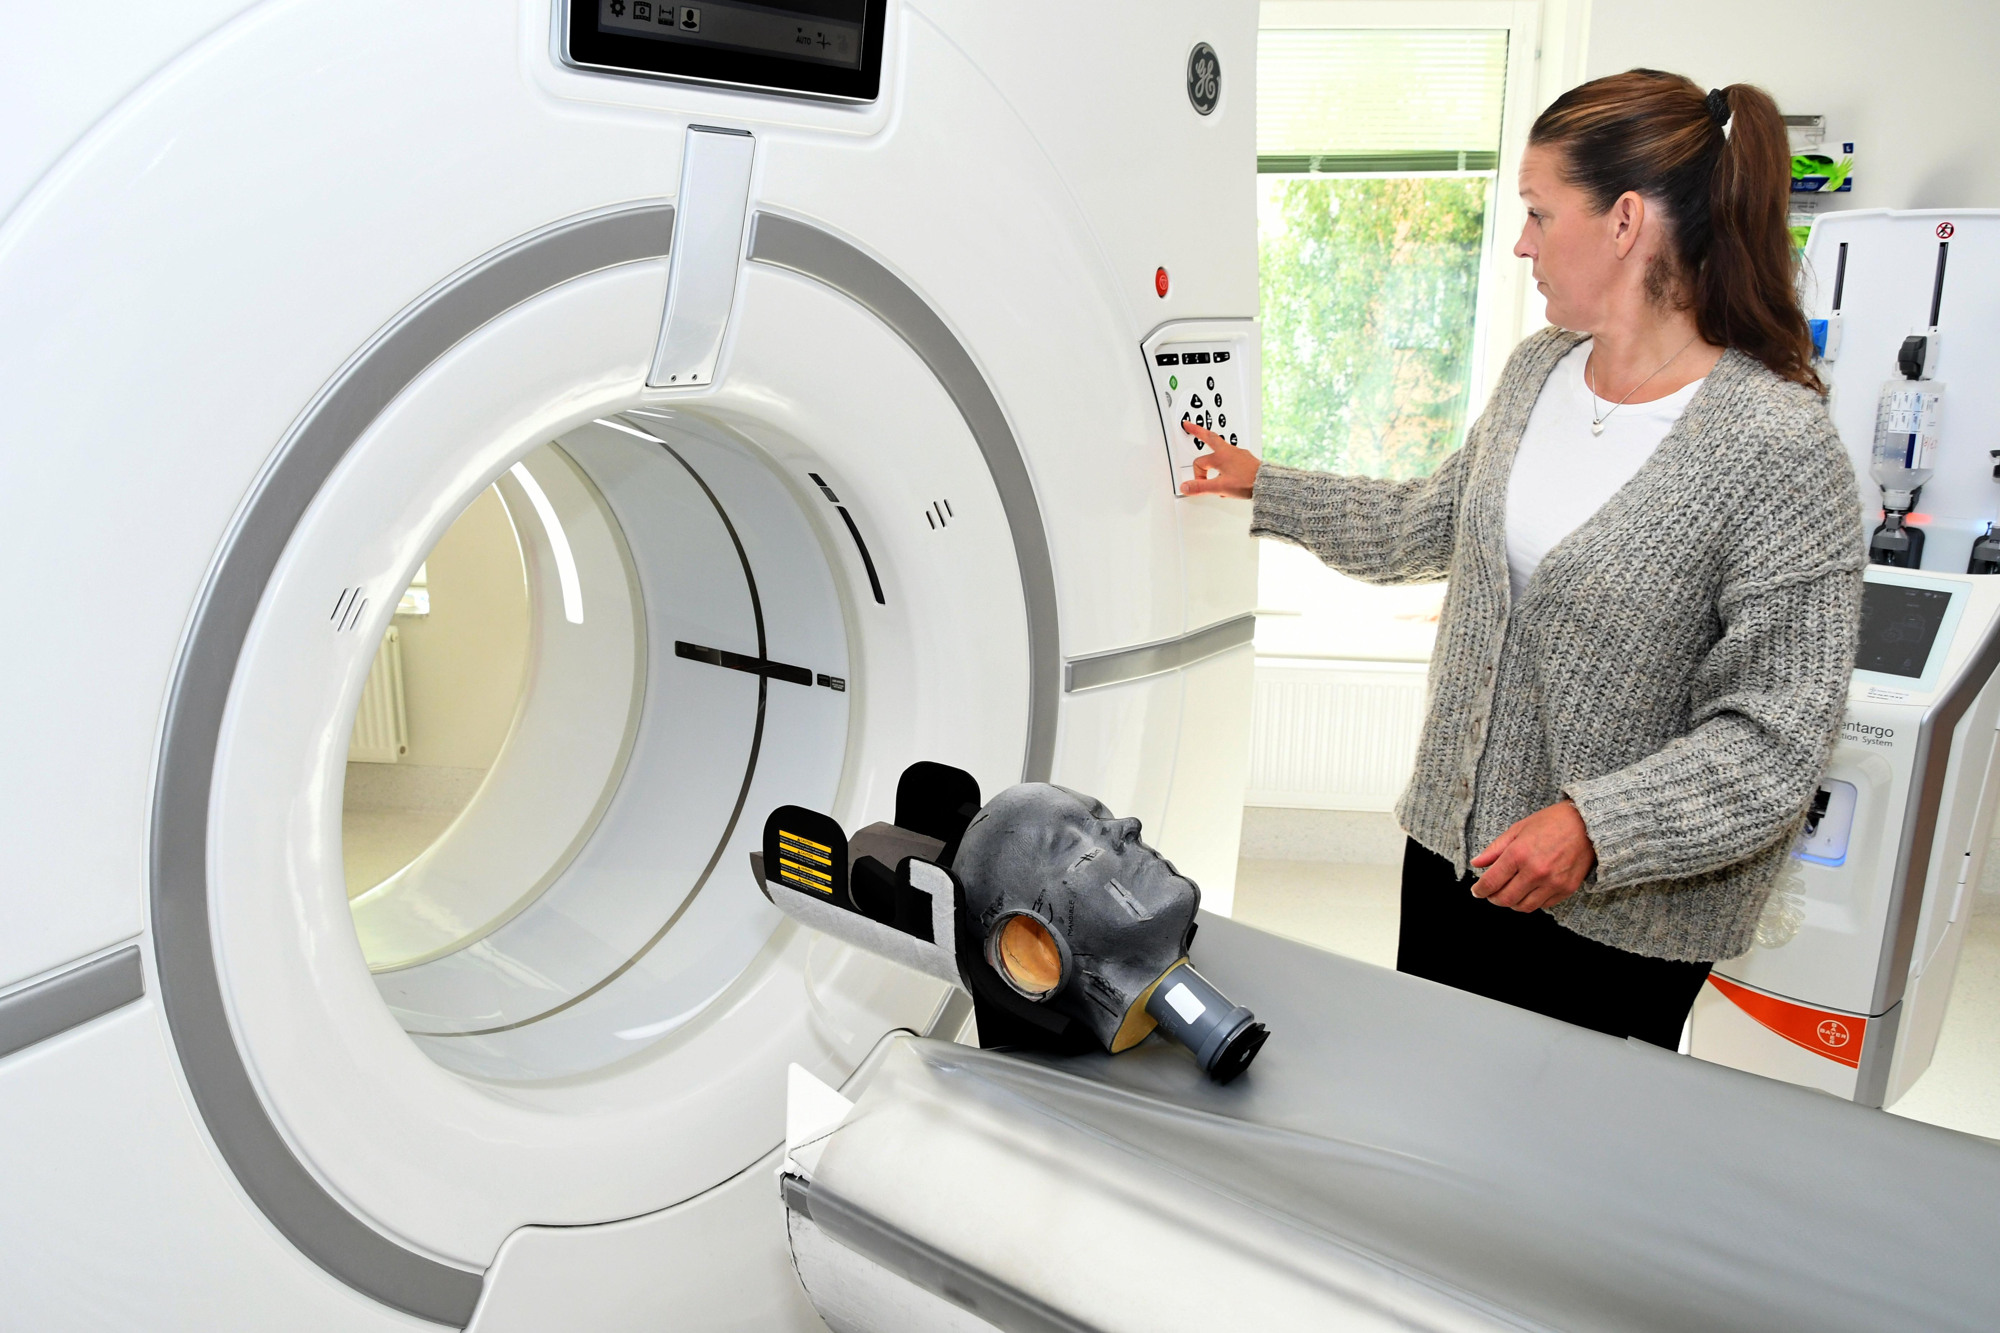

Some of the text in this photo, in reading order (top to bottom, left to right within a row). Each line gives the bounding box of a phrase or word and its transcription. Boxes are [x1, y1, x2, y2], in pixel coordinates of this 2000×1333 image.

[1841, 721, 1894, 738] entargo
[1861, 735, 1893, 747] System
[1819, 1028, 1847, 1039] BAYER
